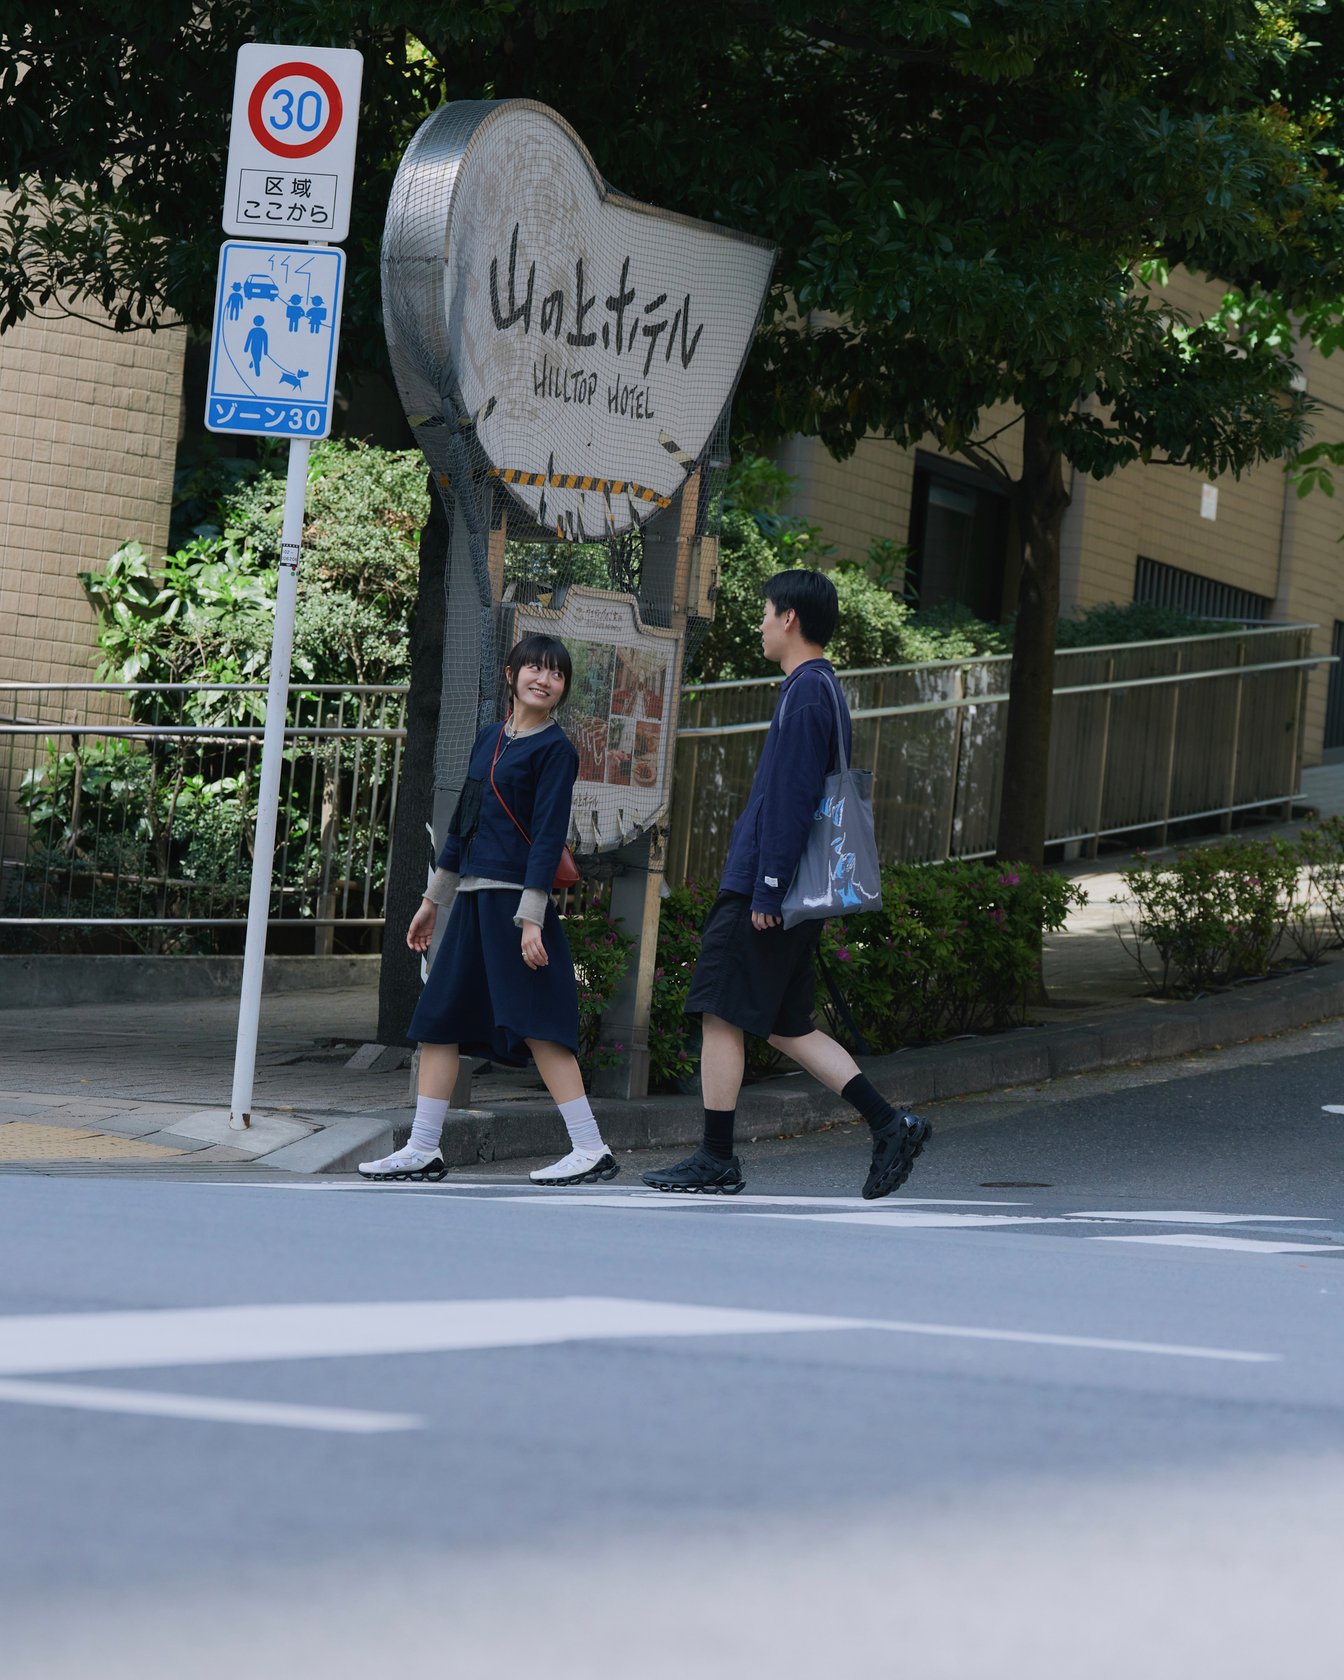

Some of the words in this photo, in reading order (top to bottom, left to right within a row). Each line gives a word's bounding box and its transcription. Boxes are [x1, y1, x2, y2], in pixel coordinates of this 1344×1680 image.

[269, 89, 323, 132] 30
[265, 177, 312, 199] 区域
[243, 200, 329, 223] ここから
[490, 222, 704, 379] 山の上ホテル
[532, 353, 598, 405] HILLTOP
[608, 373, 655, 419] HOTEL
[215, 402, 321, 432] ゾーン30
